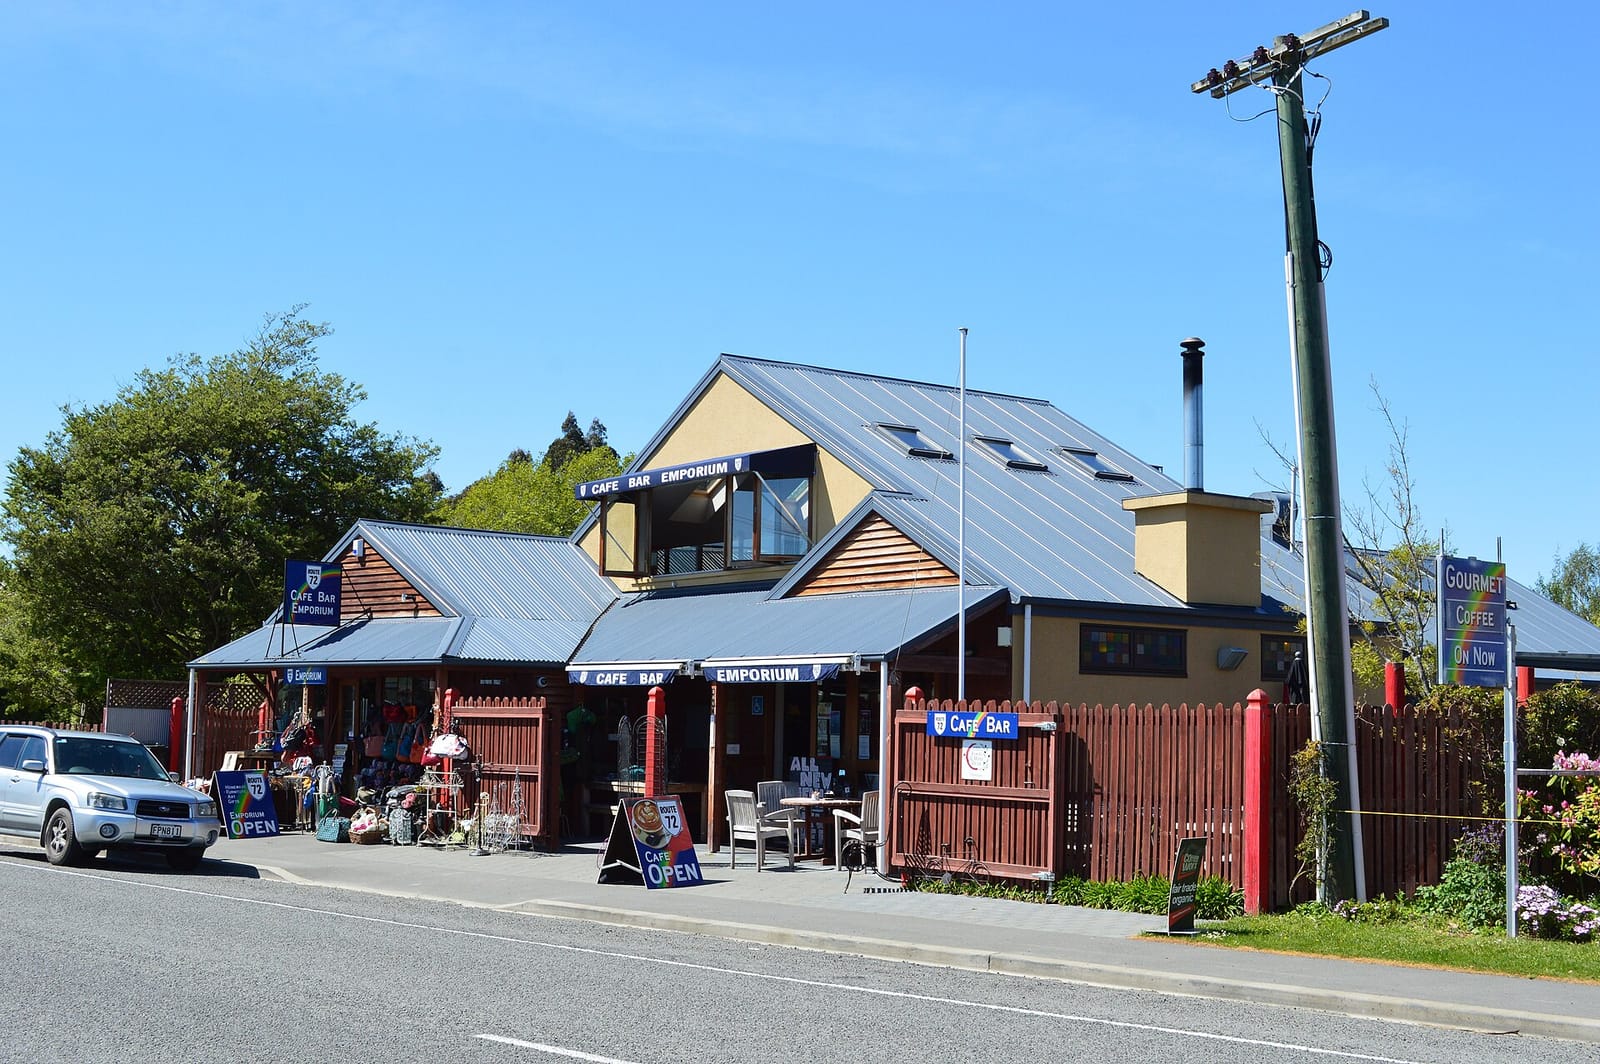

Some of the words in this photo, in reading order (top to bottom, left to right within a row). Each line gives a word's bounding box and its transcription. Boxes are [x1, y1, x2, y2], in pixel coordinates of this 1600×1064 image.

[592, 480, 619, 495] CAFE
[628, 475, 650, 488] BAR
[661, 462, 728, 483] EMPORIUM
[309, 576, 318, 585] 72
[1446, 564, 1503, 594] GOURMET
[290, 590, 313, 602] CAFE
[318, 591, 336, 603] BAR
[292, 602, 334, 616] EMPORIUM
[1456, 605, 1494, 627] COFFEE
[1454, 645, 1469, 665] ON
[1473, 646, 1496, 666] NOW
[295, 670, 322, 680] EMPORIUM
[596, 672, 627, 685] CAFE
[639, 672, 664, 684] BAR
[716, 668, 799, 682] EMPORIUM
[950, 715, 979, 732] CAFE
[986, 716, 1010, 734] BAR
[790, 756, 819, 772] ALL
[800, 771, 832, 789] NEW
[251, 784, 263, 794] 72
[660, 805, 677, 814] ROUTE
[231, 820, 276, 835] OPEN
[664, 815, 679, 829] 72
[645, 851, 670, 863] CAFE
[648, 863, 699, 884] OPEN
[1172, 883, 1181, 894] fair
[1181, 882, 1196, 893] trade
[1172, 892, 1194, 906] organic
